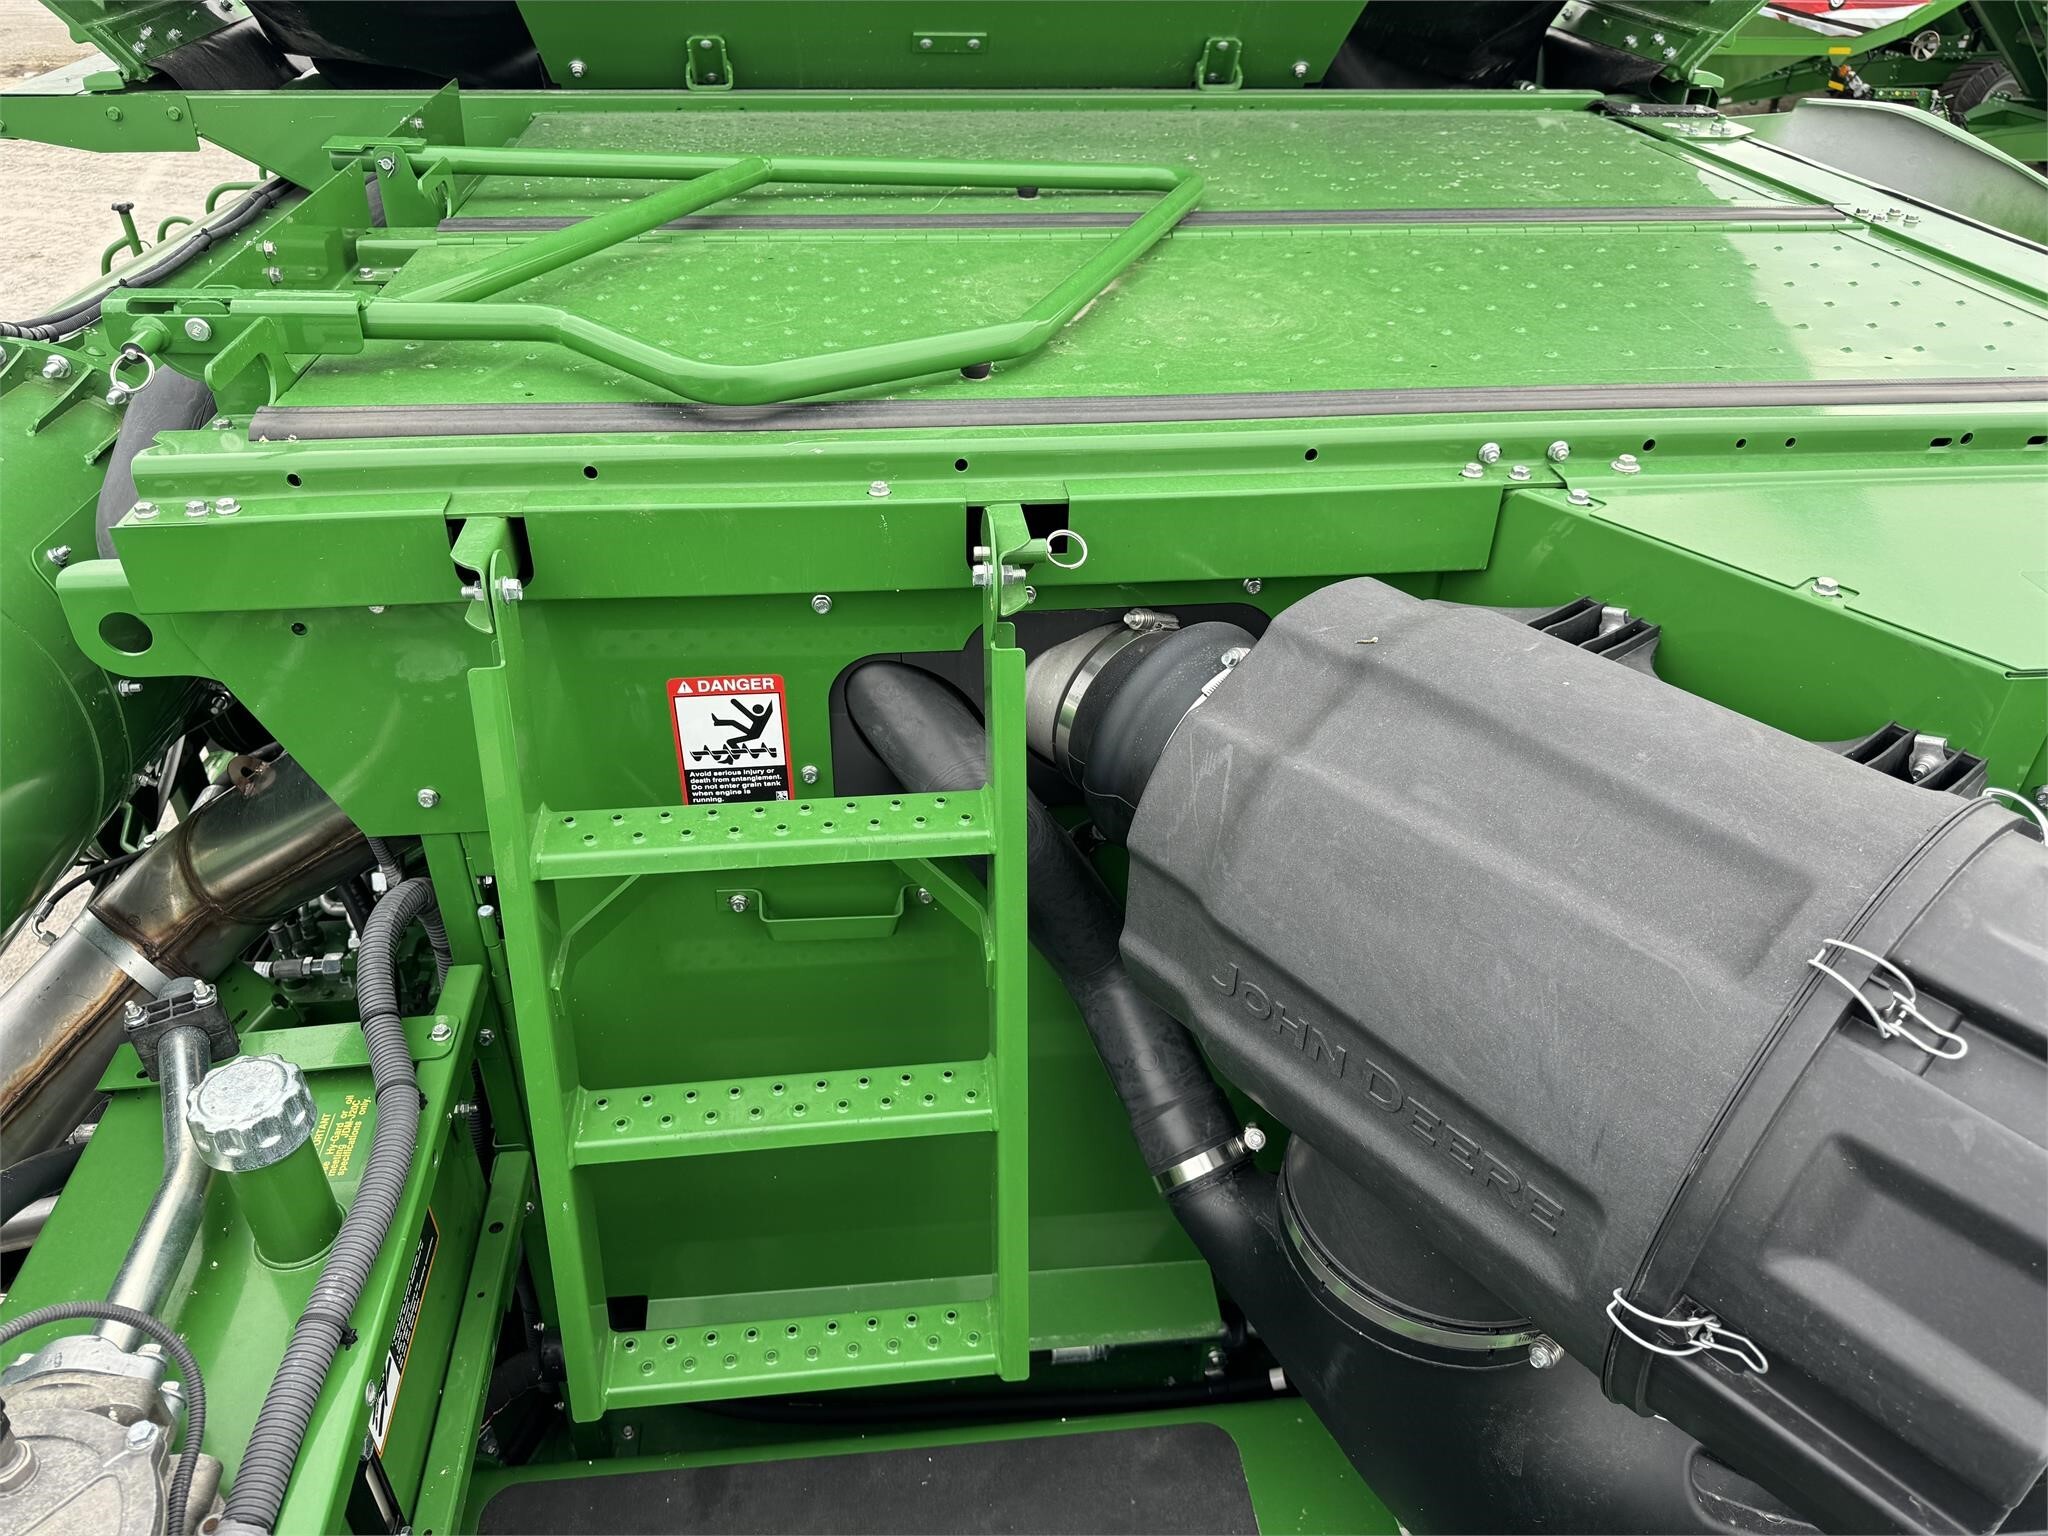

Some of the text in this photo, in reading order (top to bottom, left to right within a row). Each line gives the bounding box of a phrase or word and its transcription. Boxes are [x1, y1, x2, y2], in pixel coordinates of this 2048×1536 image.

[697, 677, 775, 692] DANGER
[715, 789, 742, 797] engine
[731, 774, 782, 783] entanglement.
[741, 781, 762, 789] grain
[1211, 962, 1566, 1236] JOHN DEERE
[313, 1113, 331, 1146] ORTANT
[325, 1122, 344, 1155] Hy-Gard
[340, 1110, 349, 1119] or
[345, 1095, 355, 1105] oil
[338, 1096, 372, 1176] specifications only.
[328, 1144, 347, 1177] meeting
